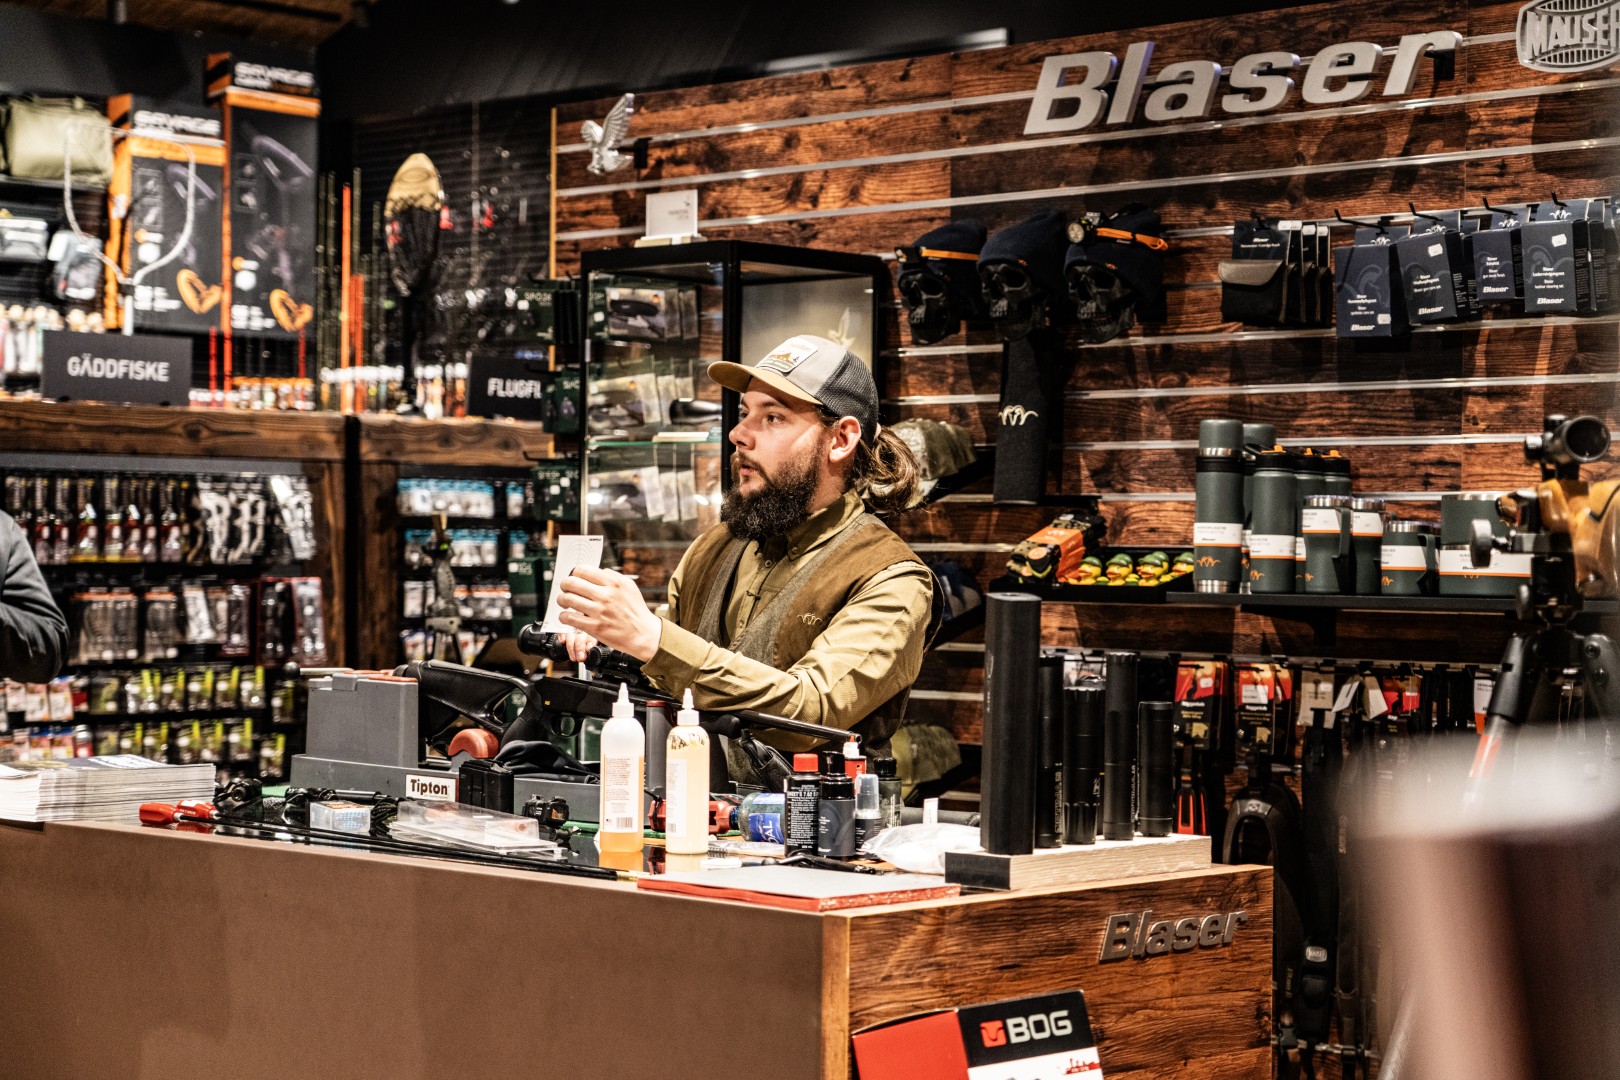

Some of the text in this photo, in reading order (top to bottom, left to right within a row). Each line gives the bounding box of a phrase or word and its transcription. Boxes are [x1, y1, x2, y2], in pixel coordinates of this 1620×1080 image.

[1022, 30, 1463, 136] Blaser
[67, 352, 170, 382] GÄDDFISKE
[487, 377, 543, 399] FLUGFI
[410, 778, 449, 796] Tipton
[1100, 909, 1249, 961] Blaser
[1005, 1009, 1073, 1044] BOG
